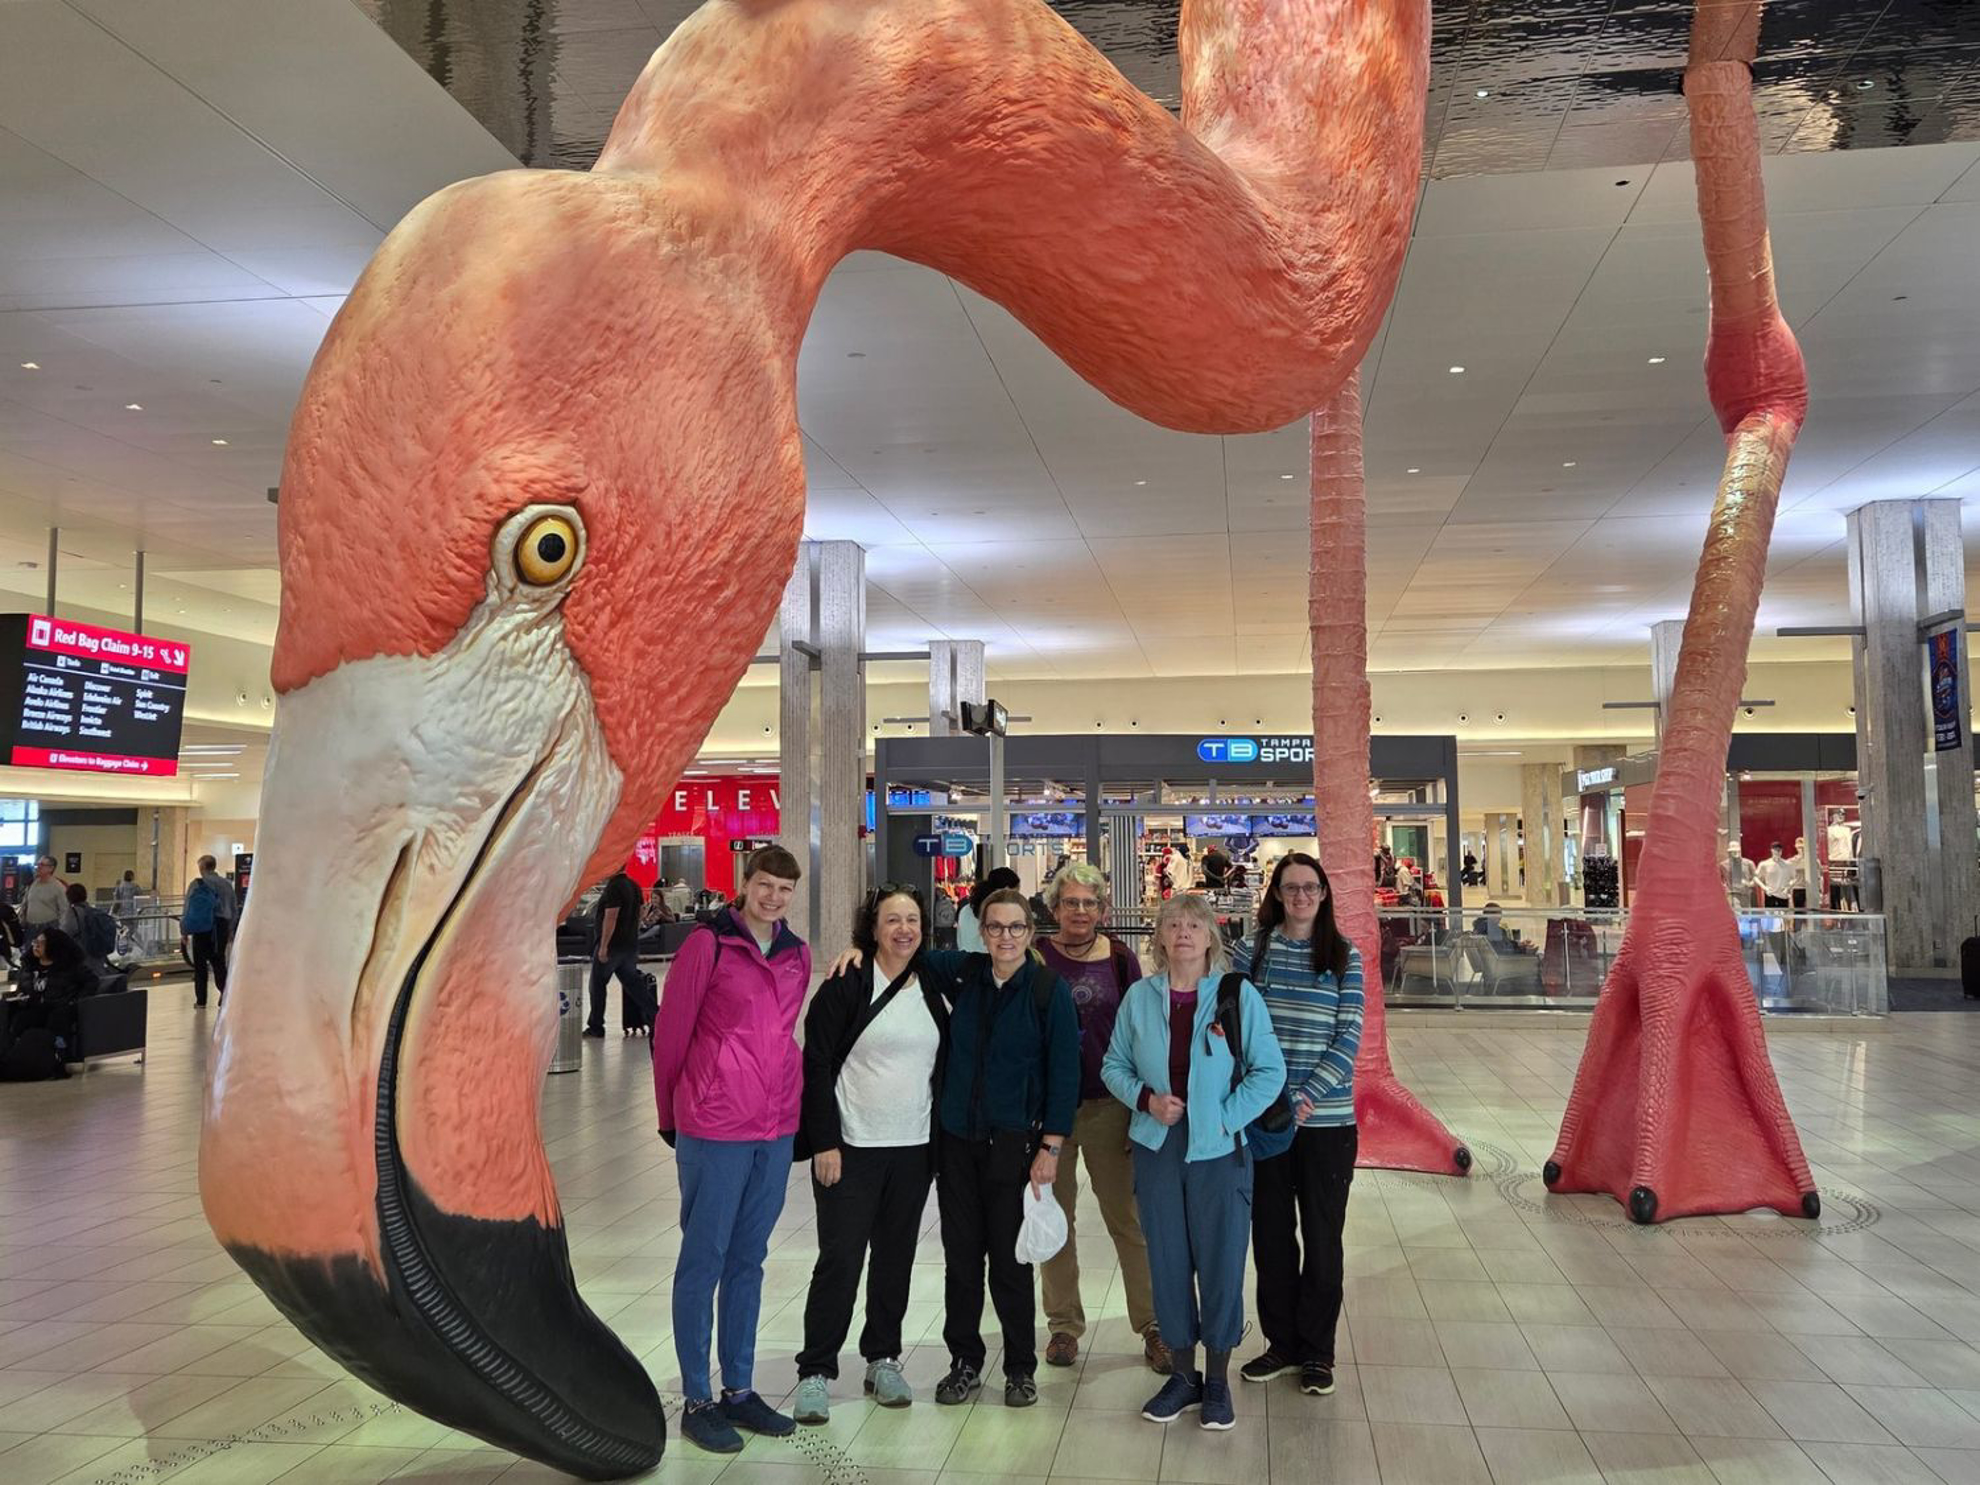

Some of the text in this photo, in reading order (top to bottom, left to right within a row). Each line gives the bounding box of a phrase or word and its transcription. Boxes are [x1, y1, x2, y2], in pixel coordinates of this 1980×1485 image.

[54, 628, 154, 660] Red Bag Claim 9-15
[1201, 741, 1255, 759] TB
[1261, 738, 1311, 747] TAMPA
[1260, 747, 1314, 762] SPOR
[1007, 842, 1064, 856] ORTS
